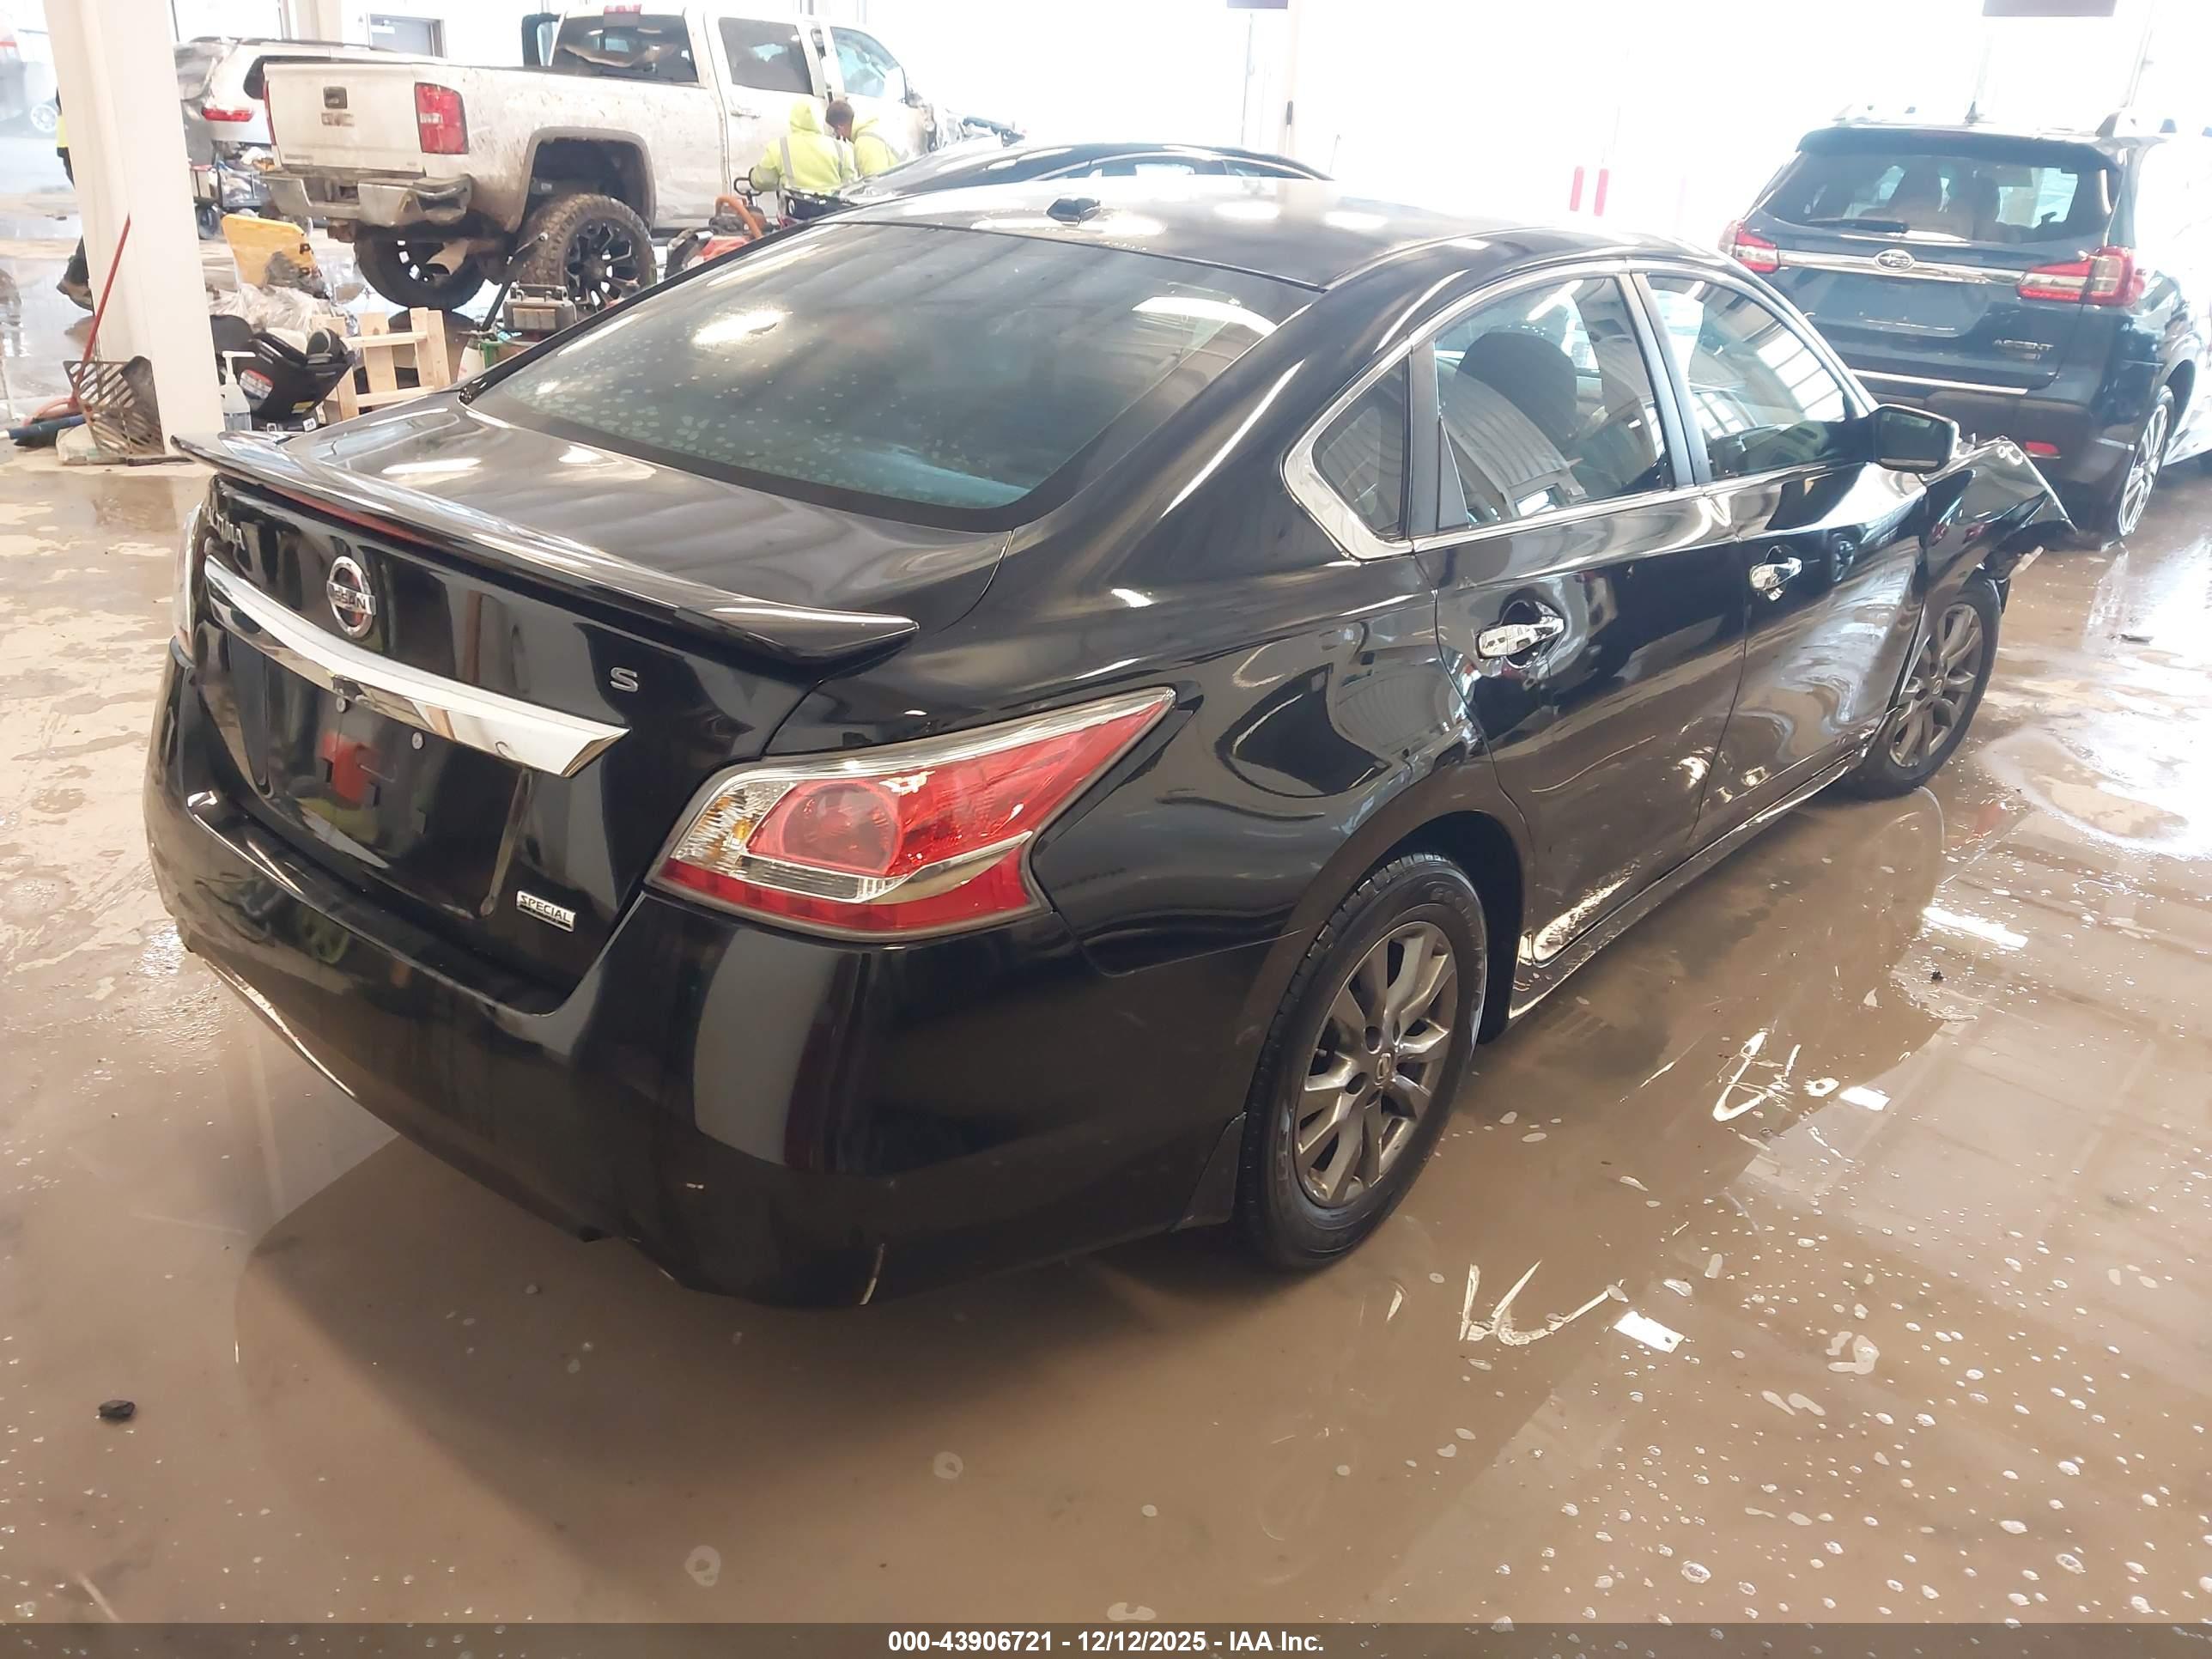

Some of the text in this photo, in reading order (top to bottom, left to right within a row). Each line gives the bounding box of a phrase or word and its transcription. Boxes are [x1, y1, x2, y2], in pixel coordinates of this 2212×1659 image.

[329, 585, 371, 611] SSAN
[611, 666, 638, 693] S
[520, 894, 572, 924] SPECIAL
